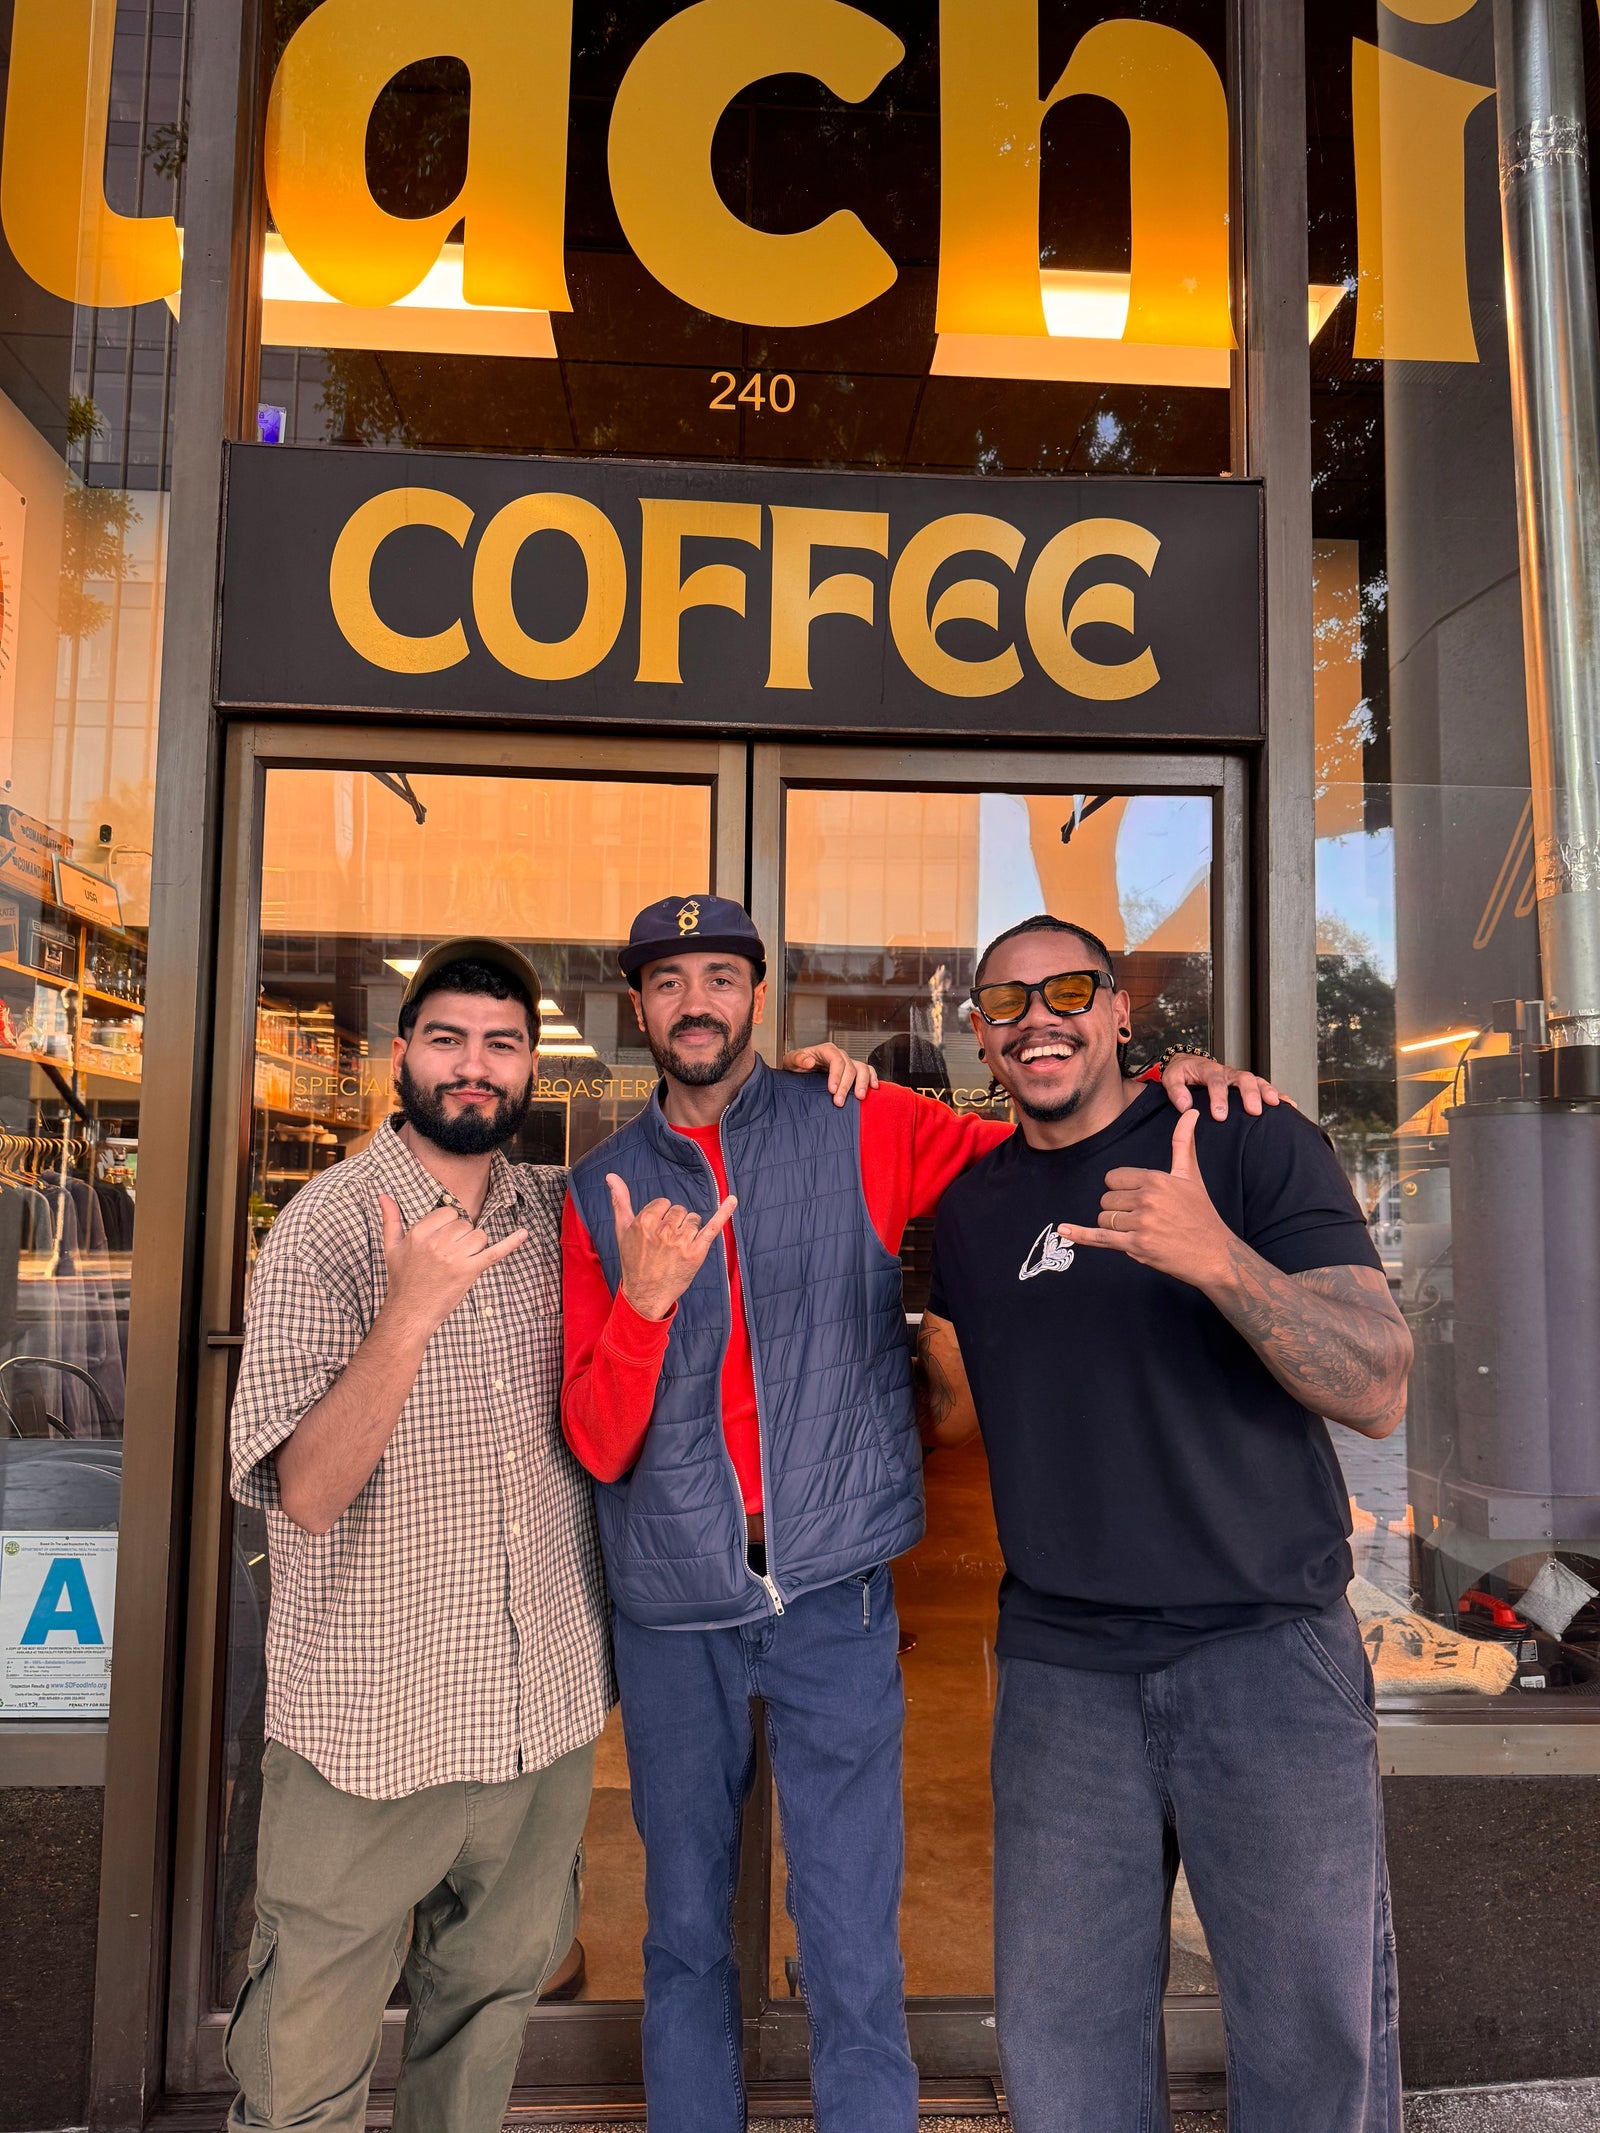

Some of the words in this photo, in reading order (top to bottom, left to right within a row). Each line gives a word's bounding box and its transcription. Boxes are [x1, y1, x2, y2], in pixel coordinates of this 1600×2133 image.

[709, 371, 796, 413] 240
[329, 487, 1162, 701] COFFEE
[17, 857, 52, 883] COMANDANT
[84, 889, 98, 904] USA
[294, 1076, 394, 1097] SPECIAL
[20, 1557, 104, 1645] A
